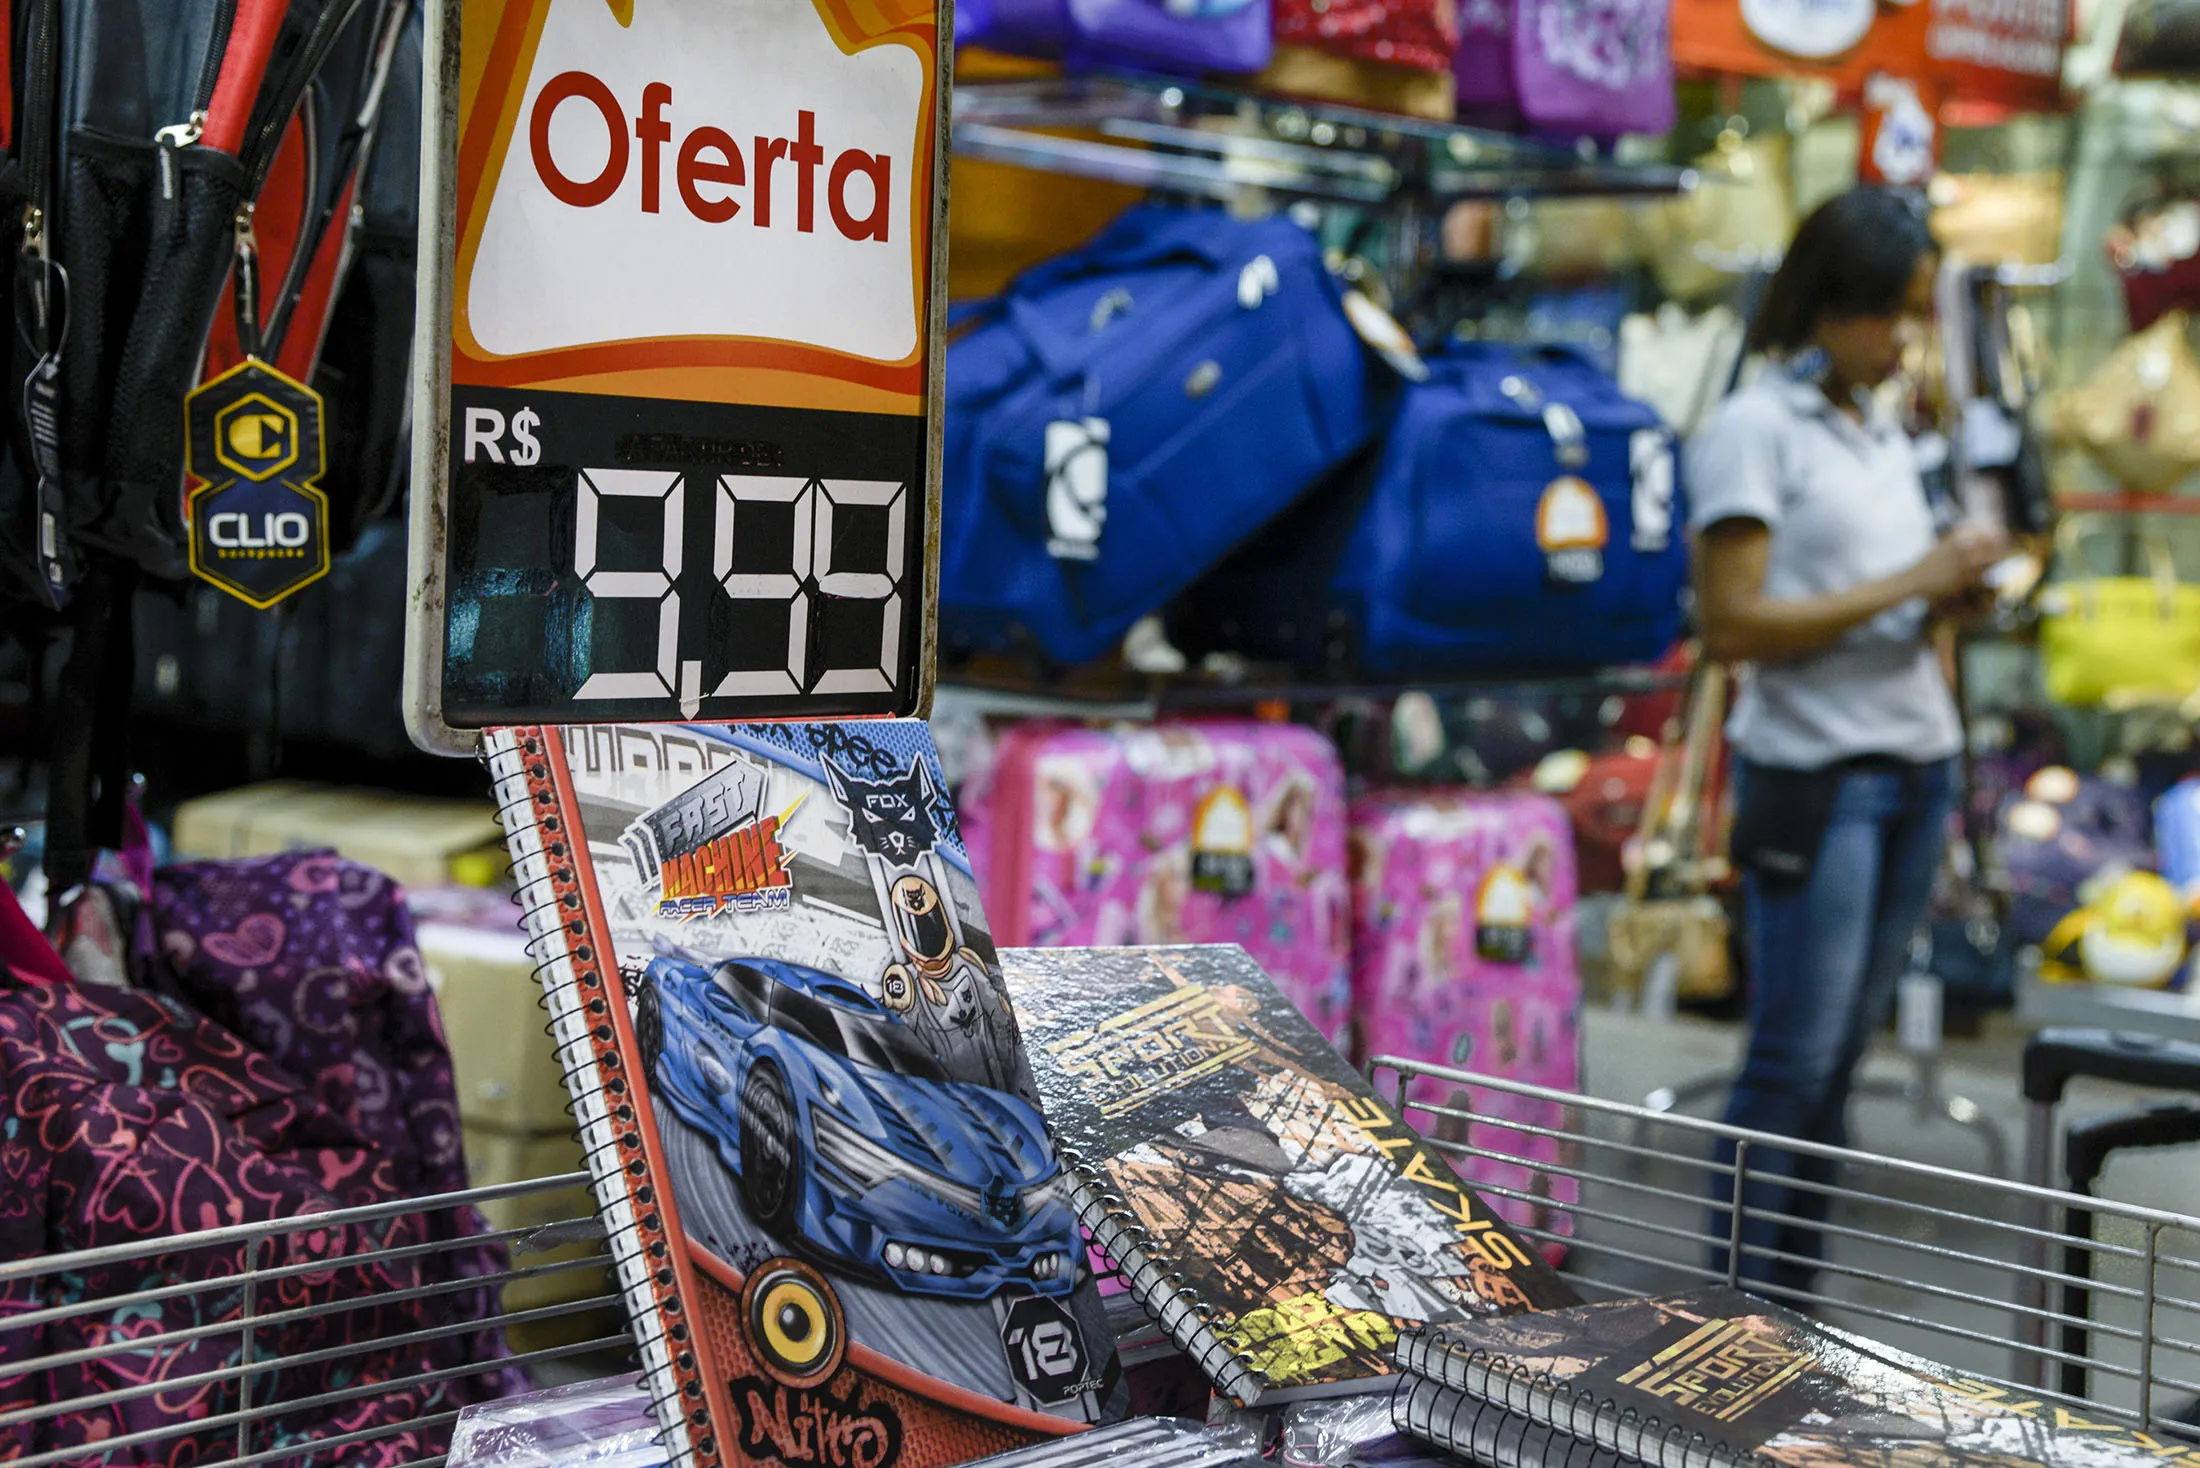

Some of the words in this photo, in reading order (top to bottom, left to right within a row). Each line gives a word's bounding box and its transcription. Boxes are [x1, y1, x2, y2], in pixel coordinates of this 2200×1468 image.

[530, 71, 891, 242] Oferta
[464, 407, 541, 465] R$
[208, 512, 309, 547] CLIO
[572, 468, 906, 720] 9,99
[659, 771, 746, 853] FAST
[866, 794, 909, 809] FOX
[661, 816, 787, 898] MACHINE
[659, 895, 717, 916] RACER
[723, 888, 789, 912] TEAM
[886, 979, 904, 994] 18
[1334, 1097, 1532, 1270] SKATE
[1008, 1320, 1078, 1381] 18
[1635, 1324, 1807, 1407] SPORT
[1063, 1379, 1104, 1396] POPTEC
